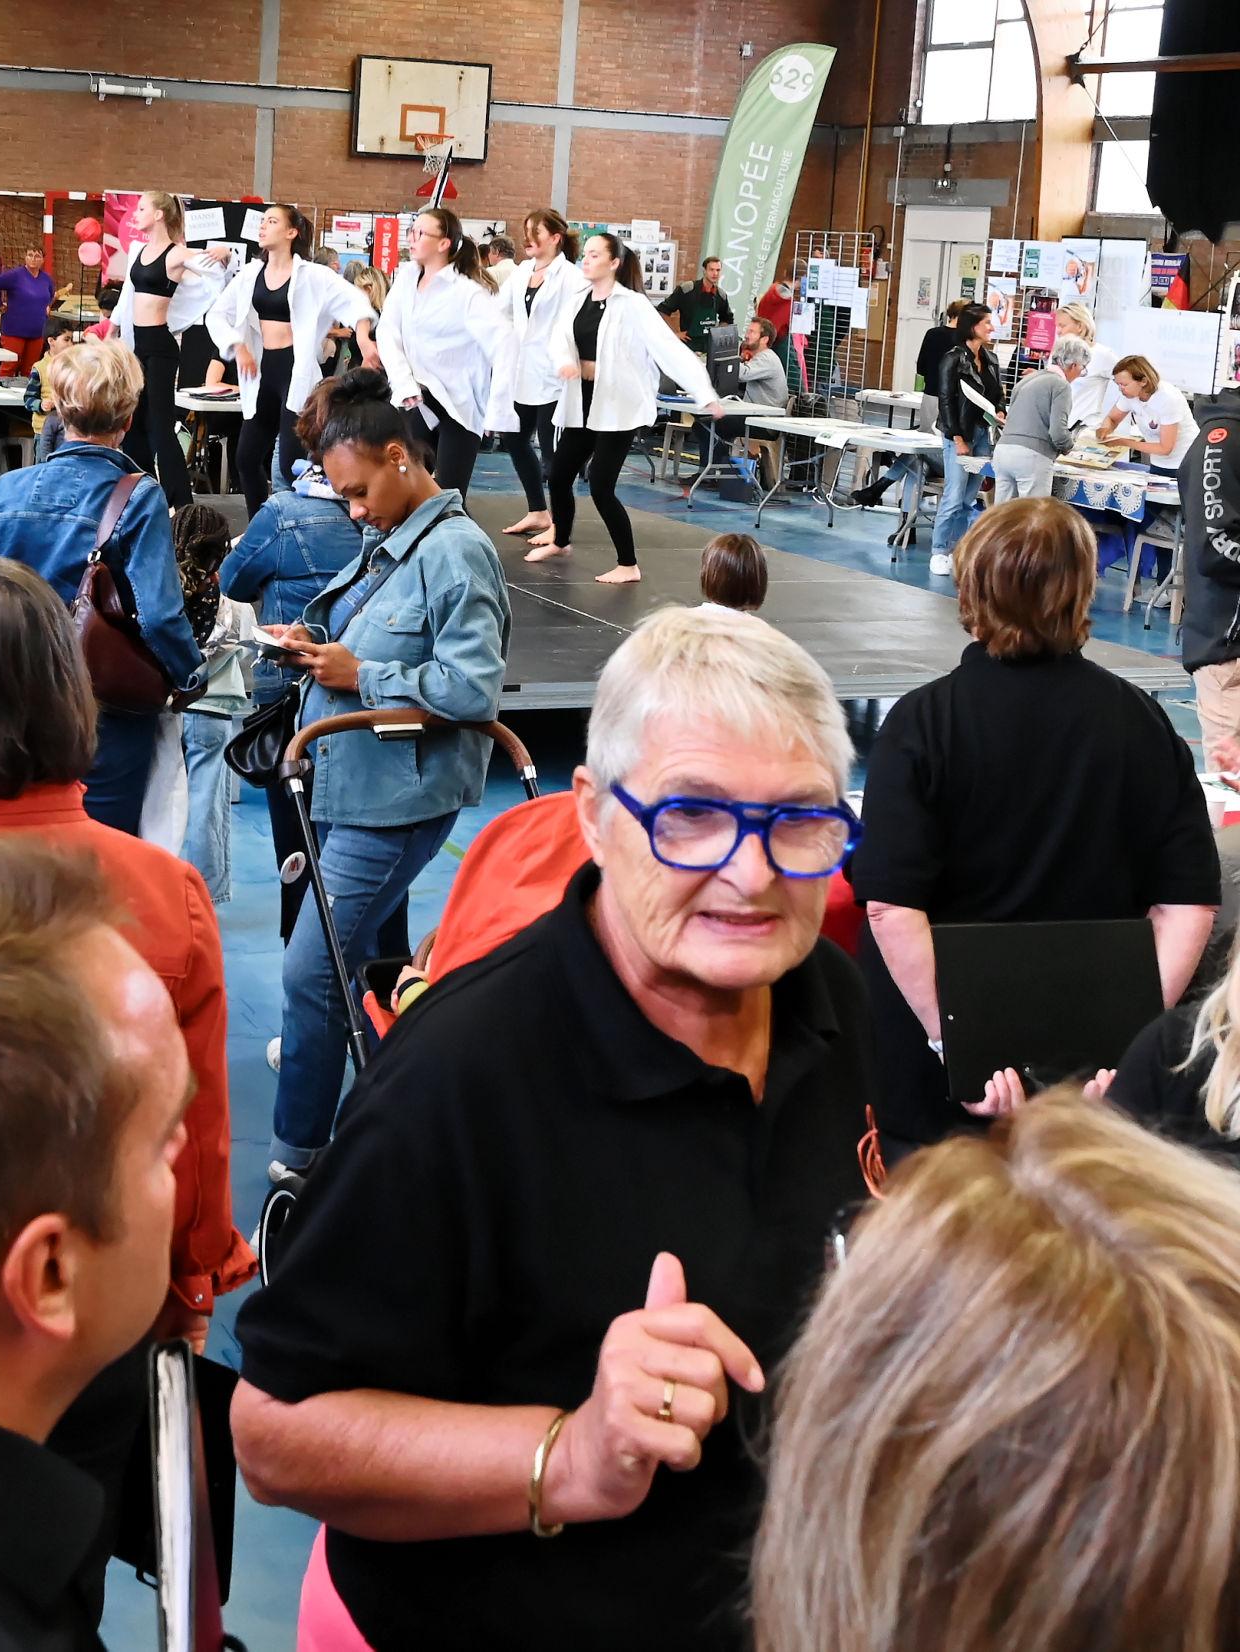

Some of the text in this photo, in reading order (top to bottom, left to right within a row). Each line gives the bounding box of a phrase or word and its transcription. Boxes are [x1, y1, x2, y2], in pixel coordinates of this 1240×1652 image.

[771, 65, 814, 92] 629
[718, 142, 773, 296] CANOPÉE
[765, 151, 793, 236] PERMACULTURE
[1203, 445, 1224, 520] SPORT
